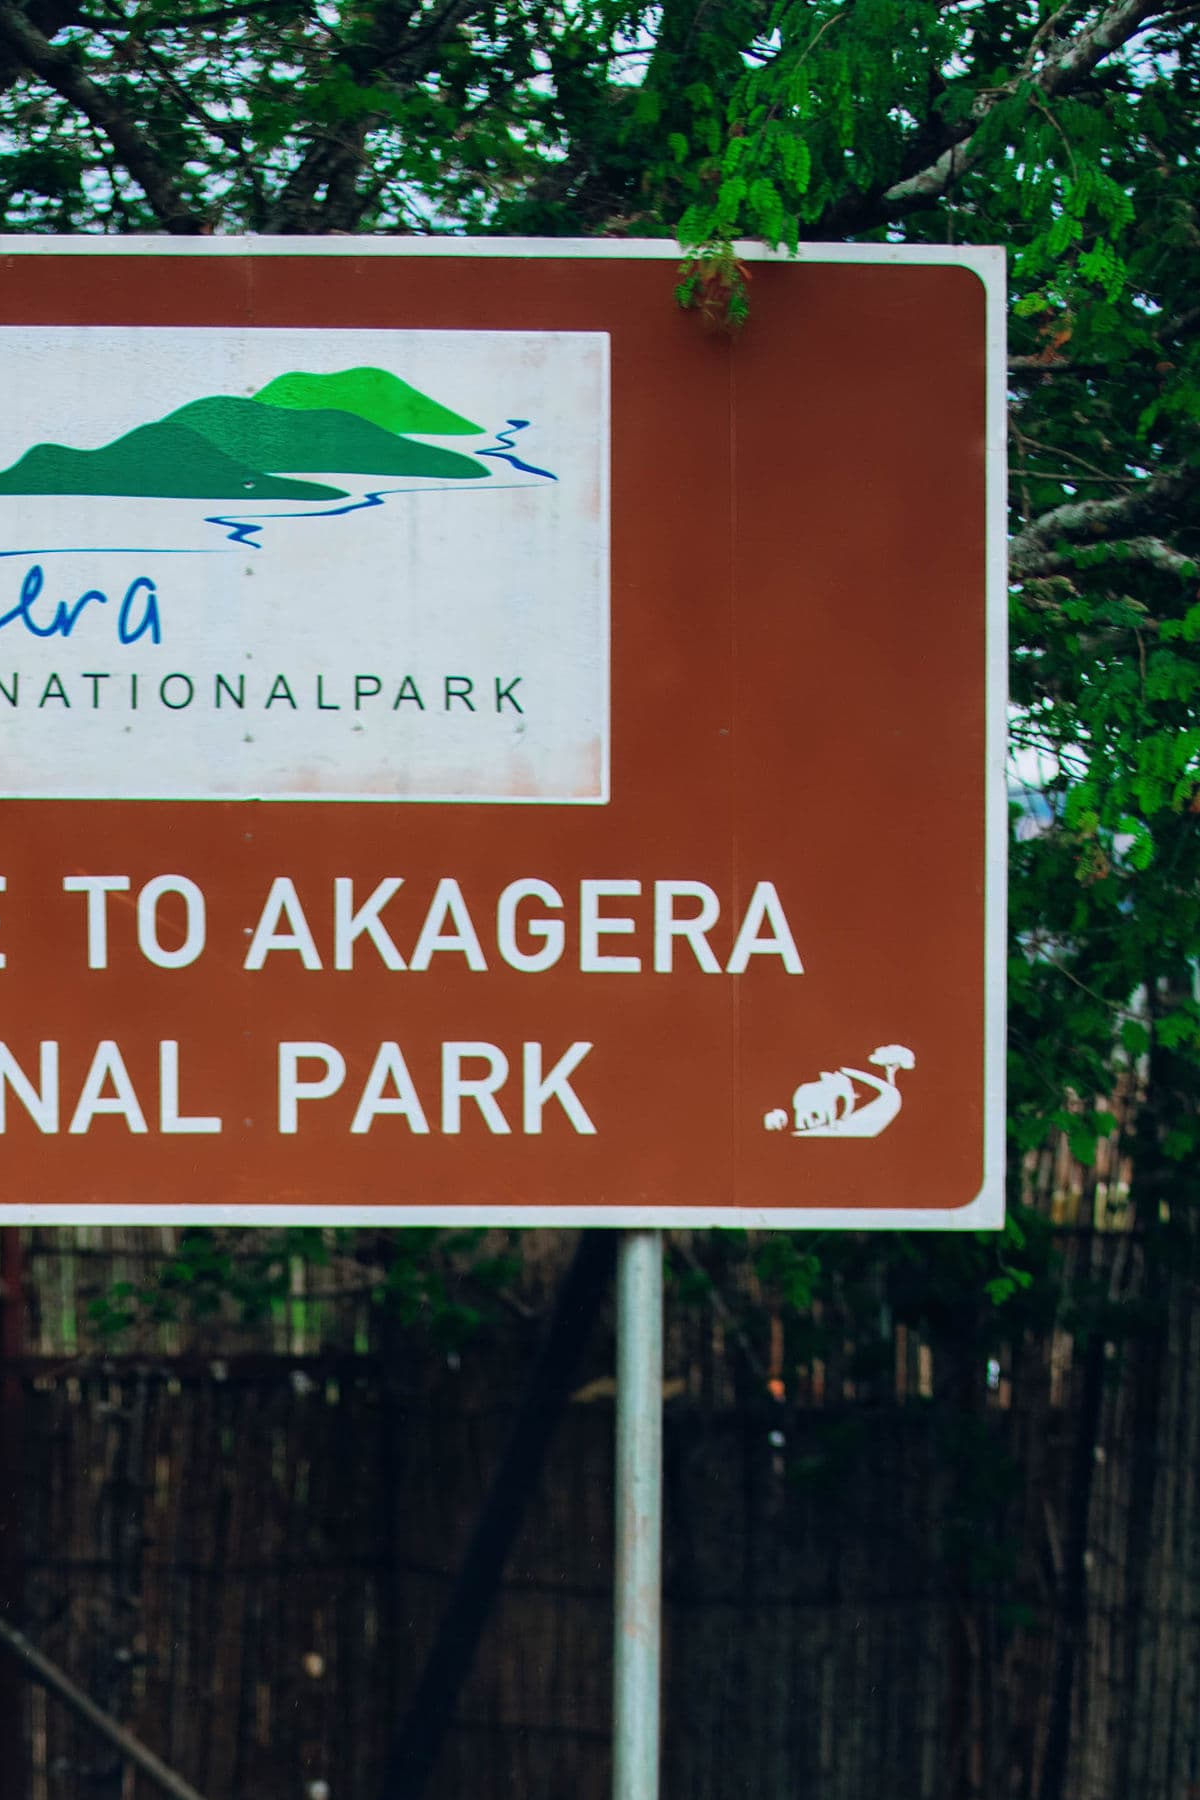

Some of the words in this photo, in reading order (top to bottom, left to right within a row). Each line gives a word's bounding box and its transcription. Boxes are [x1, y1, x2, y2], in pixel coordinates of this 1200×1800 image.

[62, 873, 207, 970] TO
[243, 875, 805, 975] AKAGERA
[278, 1040, 598, 1135] PARK
